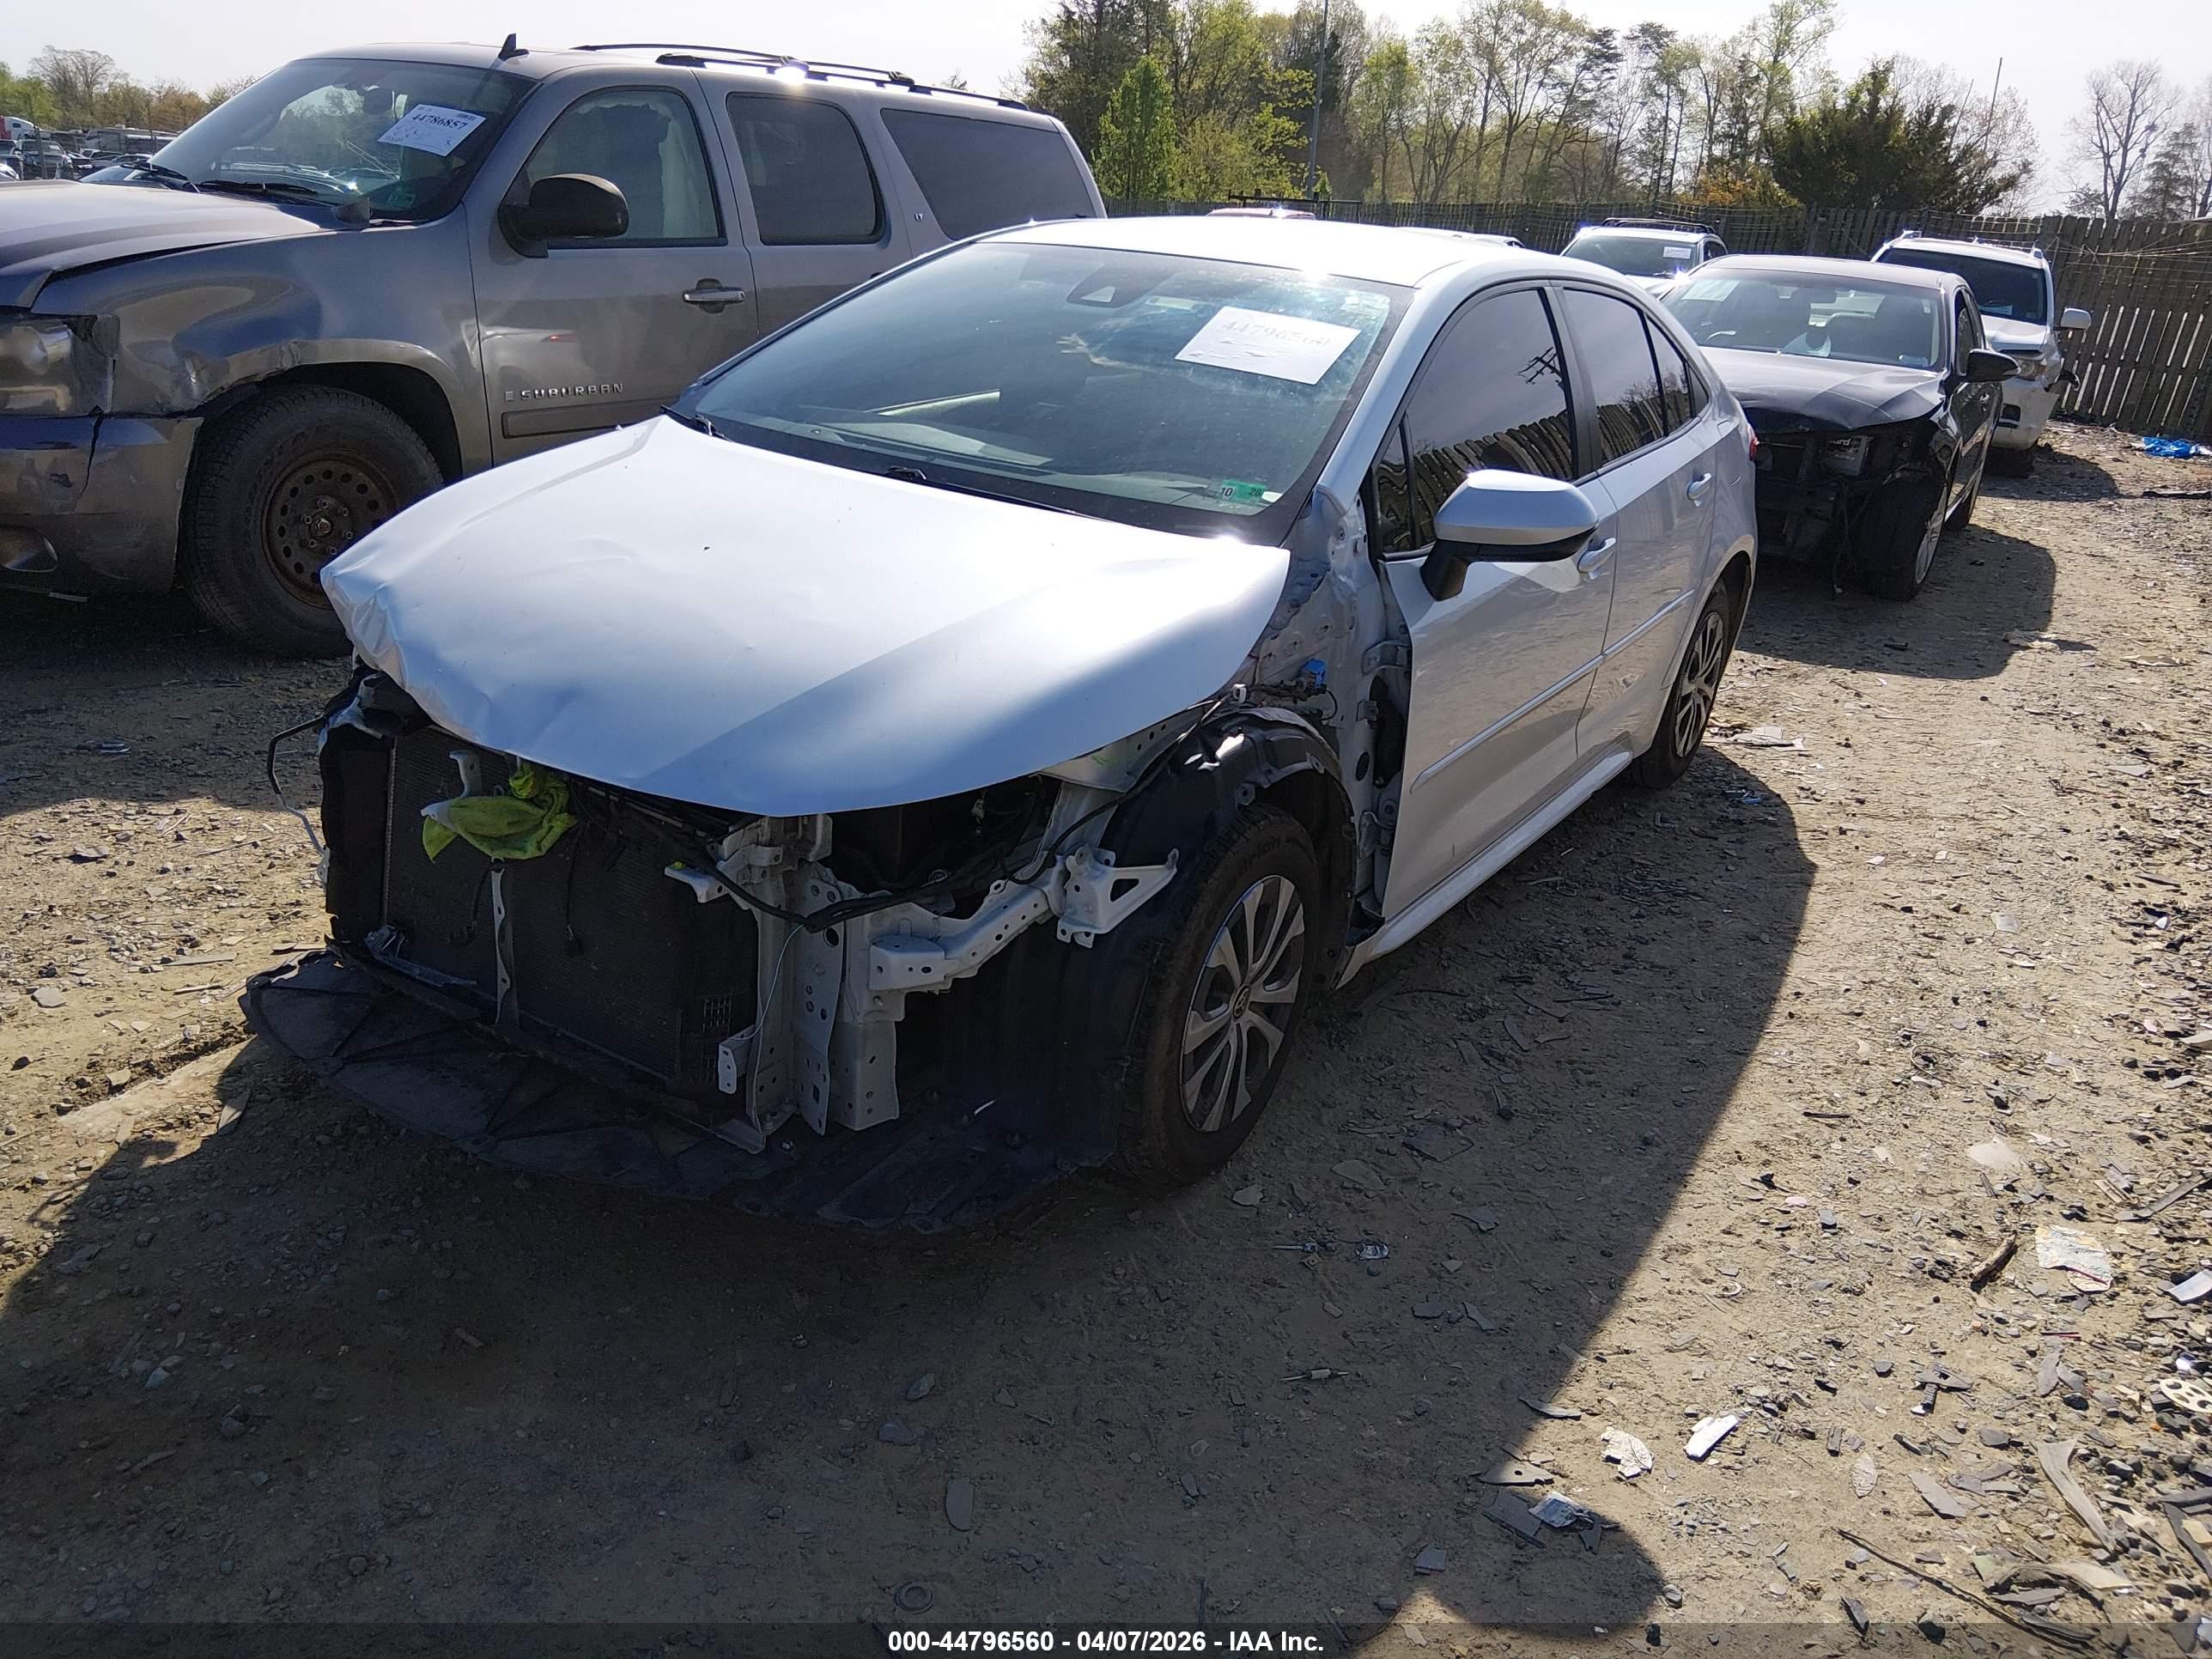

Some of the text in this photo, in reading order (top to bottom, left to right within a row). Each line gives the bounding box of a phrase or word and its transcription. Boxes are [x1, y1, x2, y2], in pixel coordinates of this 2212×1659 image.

[411, 113, 468, 130] 44786857
[520, 383, 623, 401] SUBURBAN
[1221, 487, 1234, 497] 10
